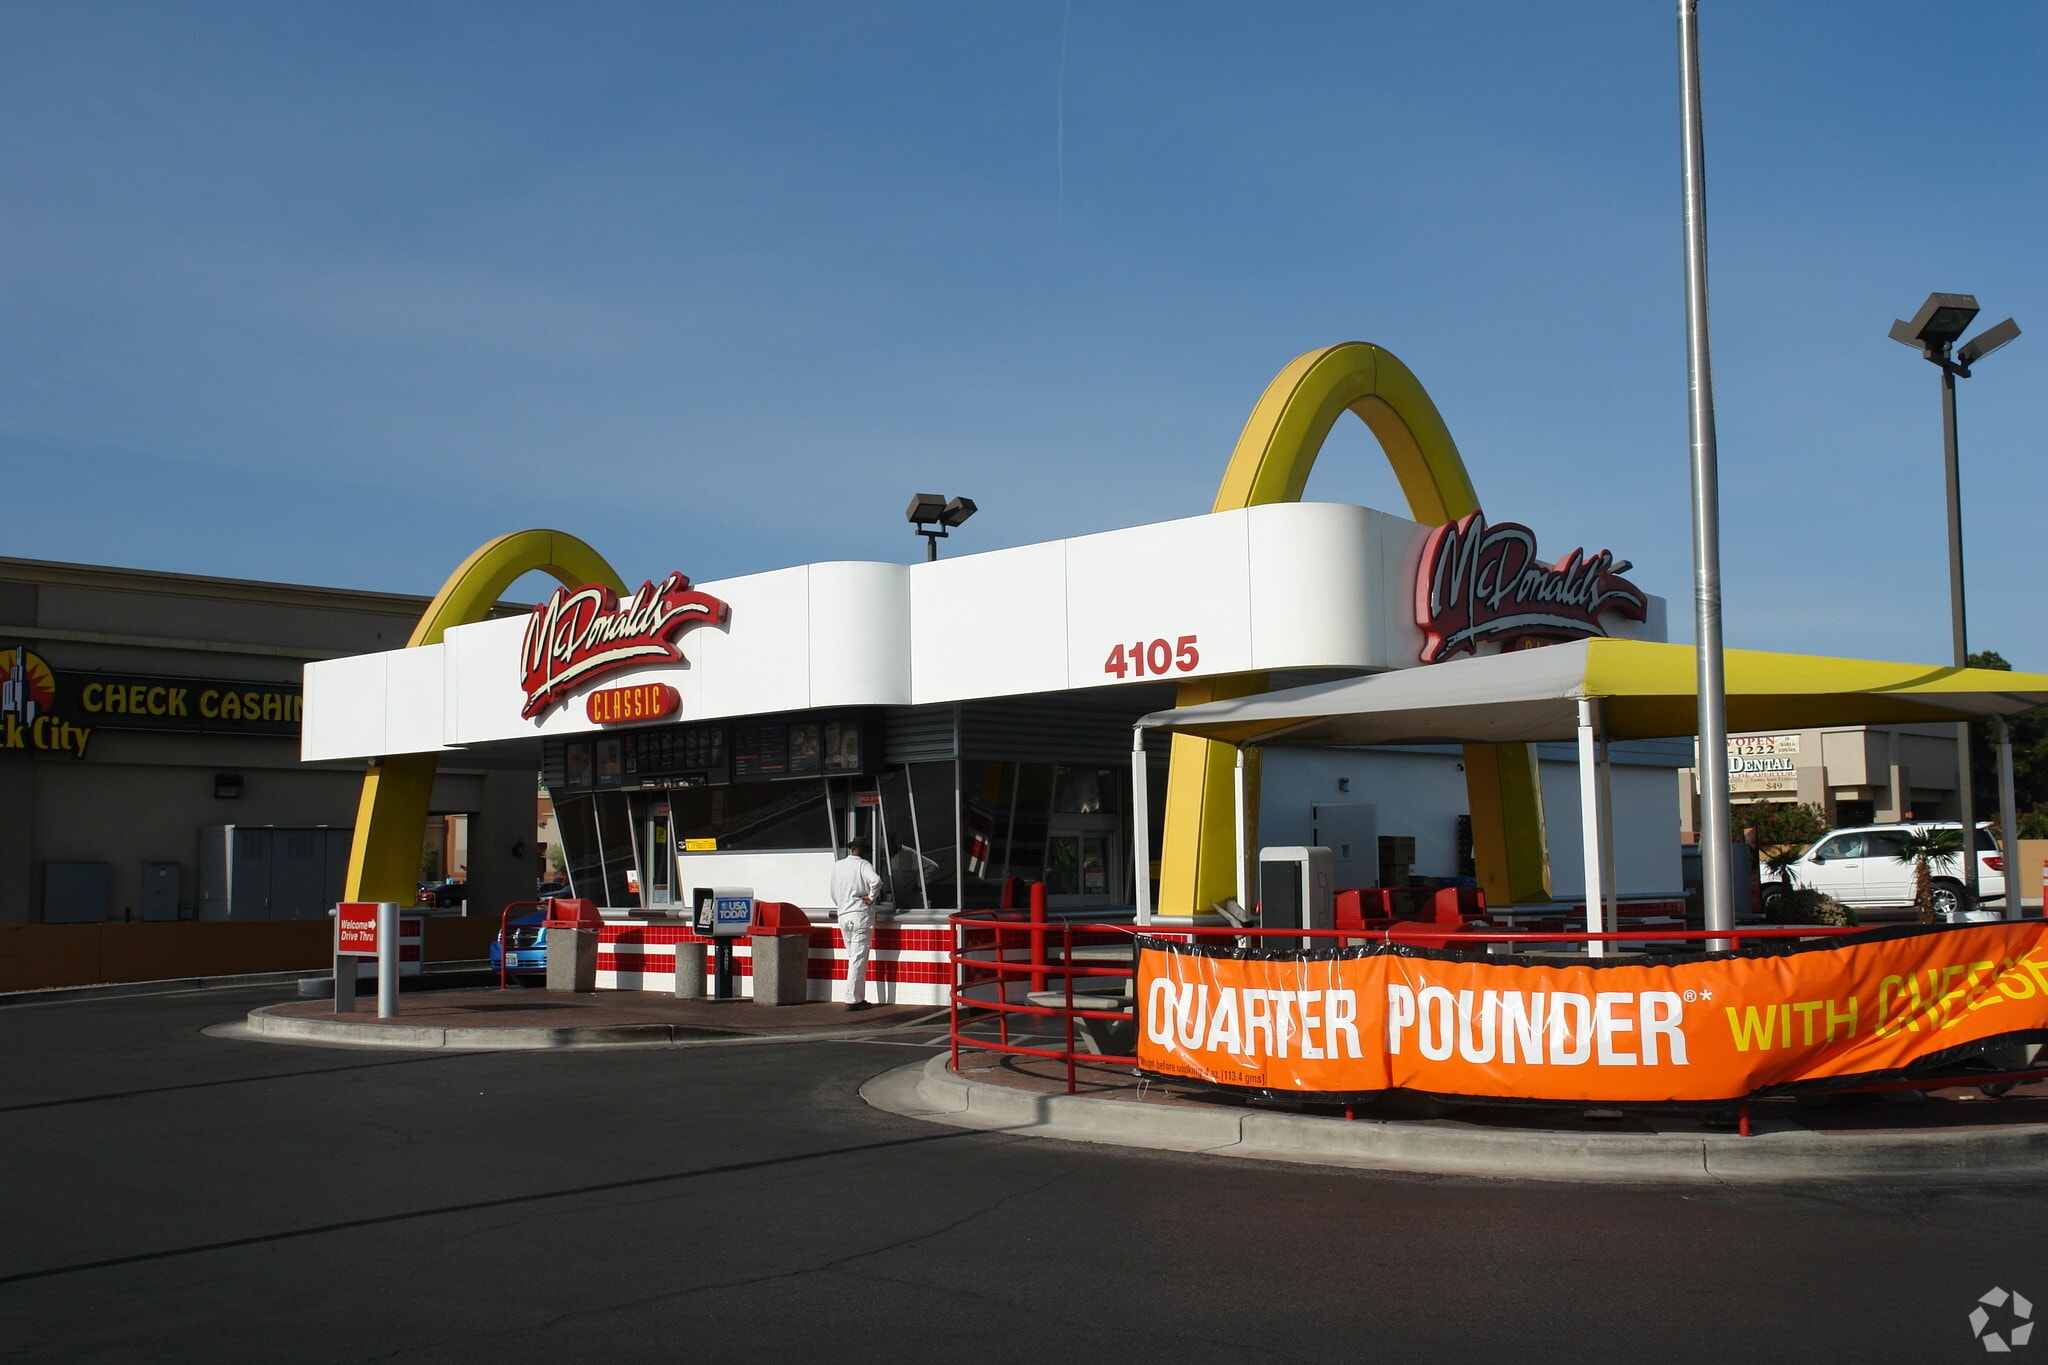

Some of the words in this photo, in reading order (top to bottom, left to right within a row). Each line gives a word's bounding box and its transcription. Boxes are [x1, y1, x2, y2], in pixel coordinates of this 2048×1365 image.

[1104, 634, 1200, 680] 4105
[82, 683, 188, 717] CHECK
[593, 685, 661, 721] CLASSIC
[33, 714, 91, 757] City
[1735, 736, 1776, 747] OPEN
[728, 901, 748, 910] USA
[719, 909, 749, 919] TODAY
[341, 919, 369, 930] Welcome
[341, 930, 358, 941] Drive
[359, 931, 374, 942] Thru
[1147, 977, 1364, 1060] QUARTER
[1725, 996, 1859, 1052] WITH
[1156, 1059, 1176, 1072] before
